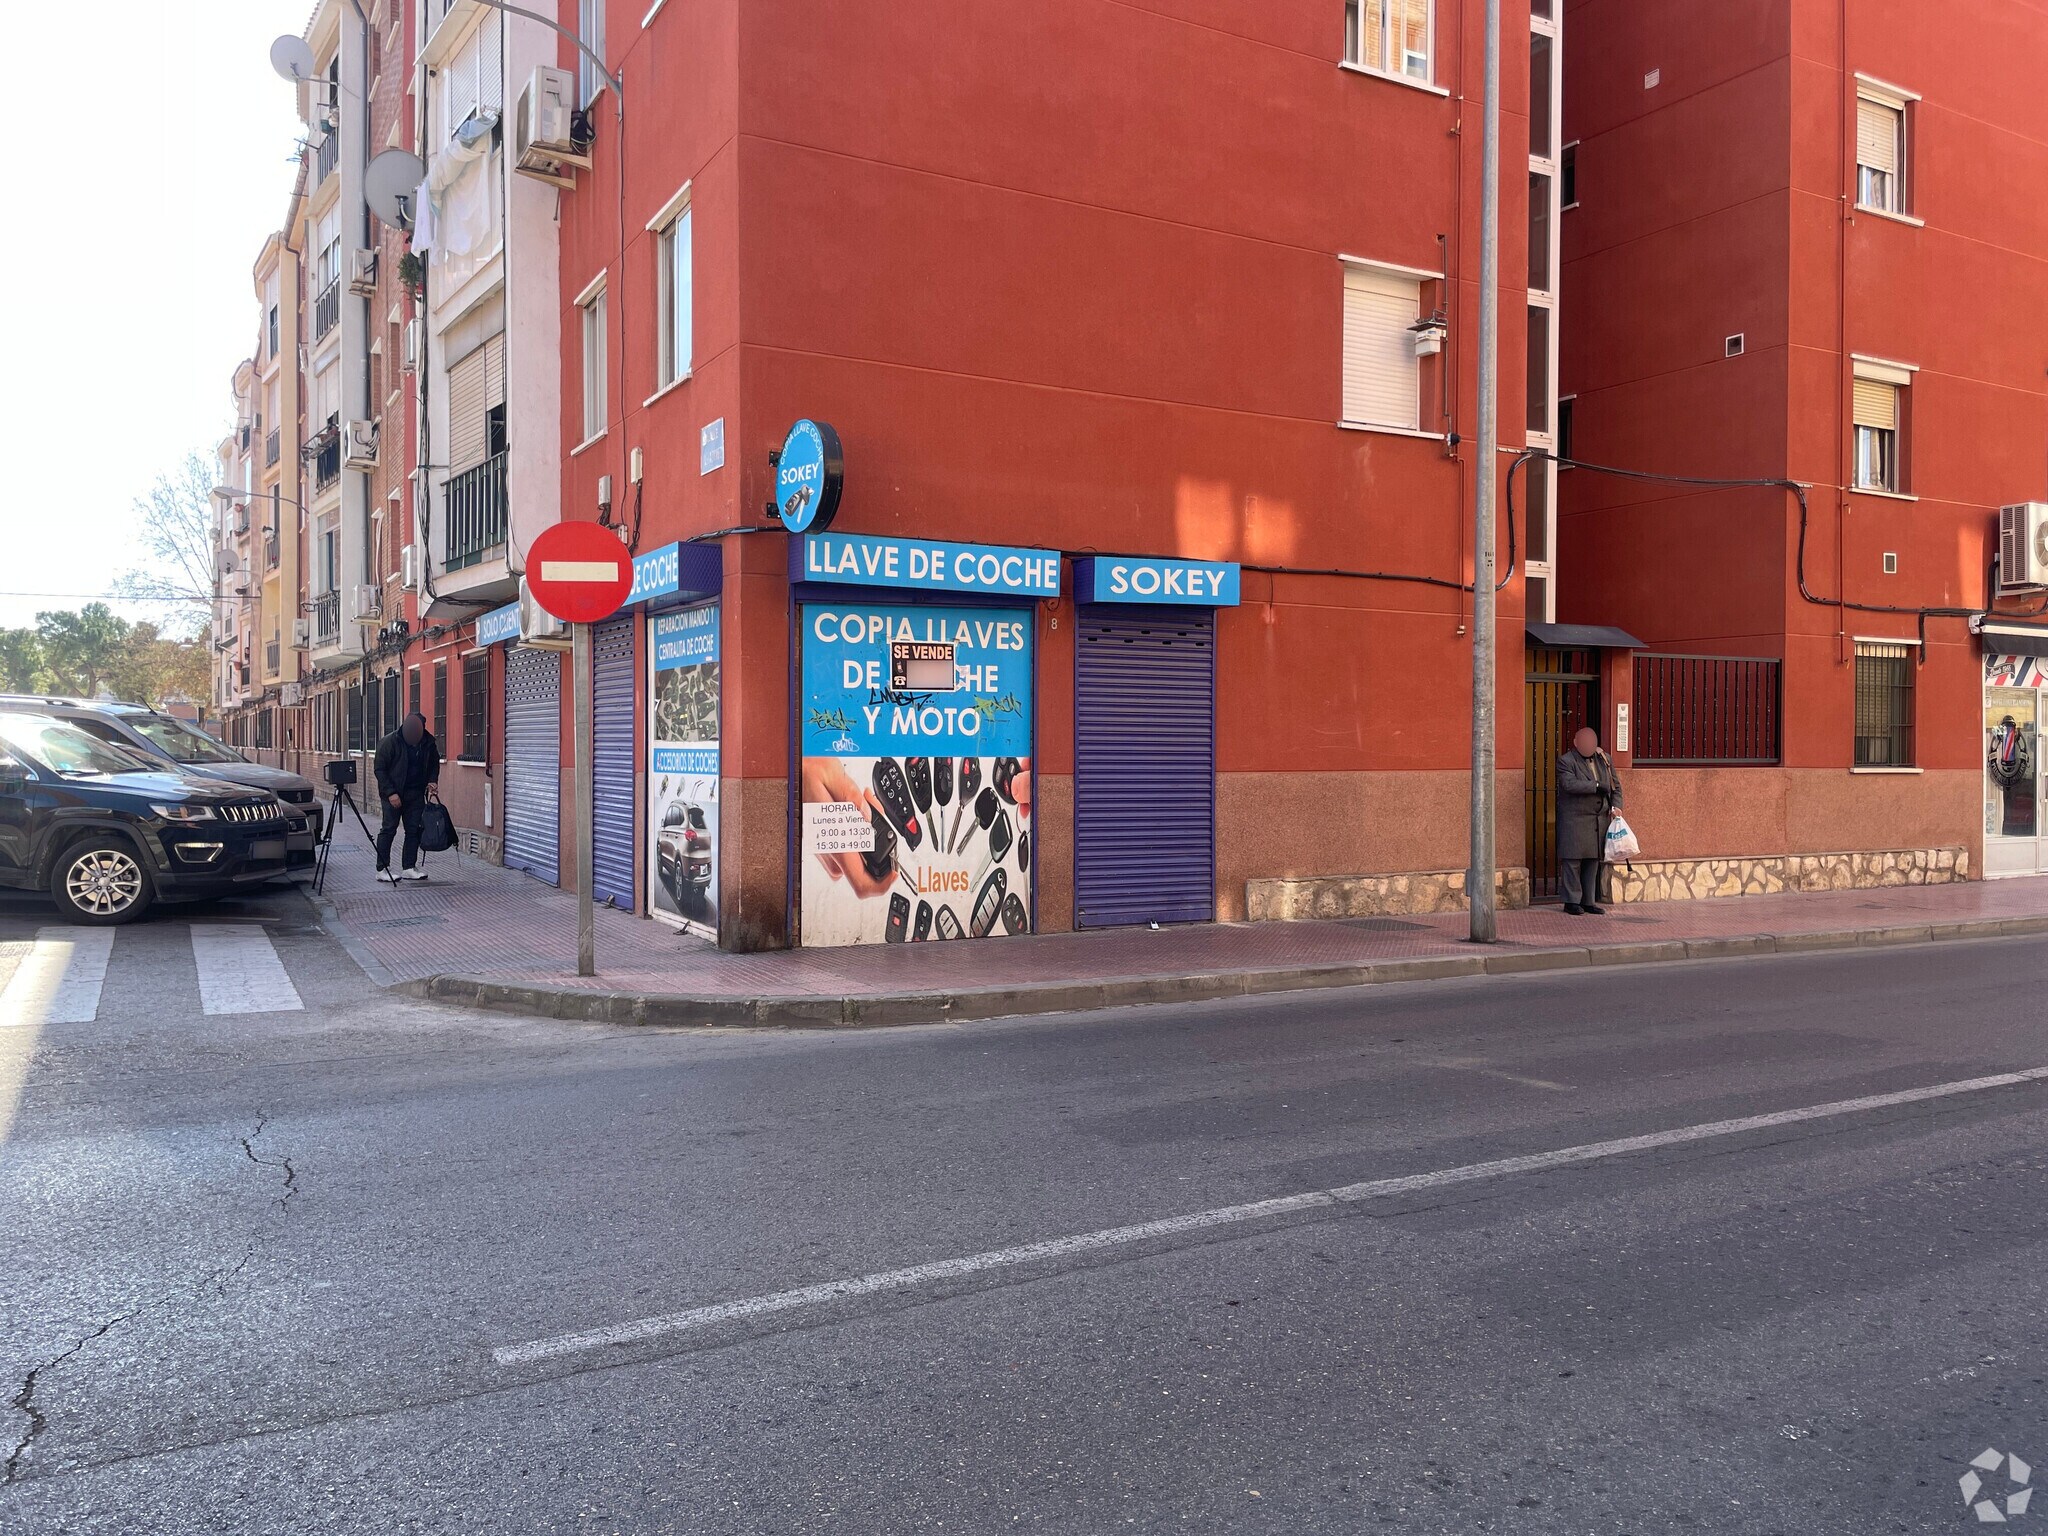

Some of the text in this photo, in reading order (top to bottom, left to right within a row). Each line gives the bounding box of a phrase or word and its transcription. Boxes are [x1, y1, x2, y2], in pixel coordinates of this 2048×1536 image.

[781, 423, 823, 466] COPIA LLAVE COCHE
[781, 462, 819, 485] SOKEY
[643, 552, 678, 592] COCHE
[809, 540, 1057, 589] LLAVE DE COCHE
[1110, 565, 1226, 597] SOKEY
[483, 616, 499, 639] SOLO
[689, 607, 710, 629] MANDO
[710, 606, 715, 624] Y
[814, 612, 914, 645] COPIA
[1051, 618, 1058, 630] 8
[658, 634, 714, 661] CENTRALITA DE COCHE
[893, 644, 952, 660] SE VENDE
[843, 660, 881, 689] DE
[862, 706, 881, 735] Y
[891, 707, 980, 736] MOTO
[657, 752, 718, 773] ACCESORIOS DE COCHES
[812, 817, 837, 825] Lunes
[821, 828, 839, 837] 9:00
[849, 827, 871, 836] 13:30
[816, 841, 839, 850] 15:30
[917, 866, 969, 893] Llaves
